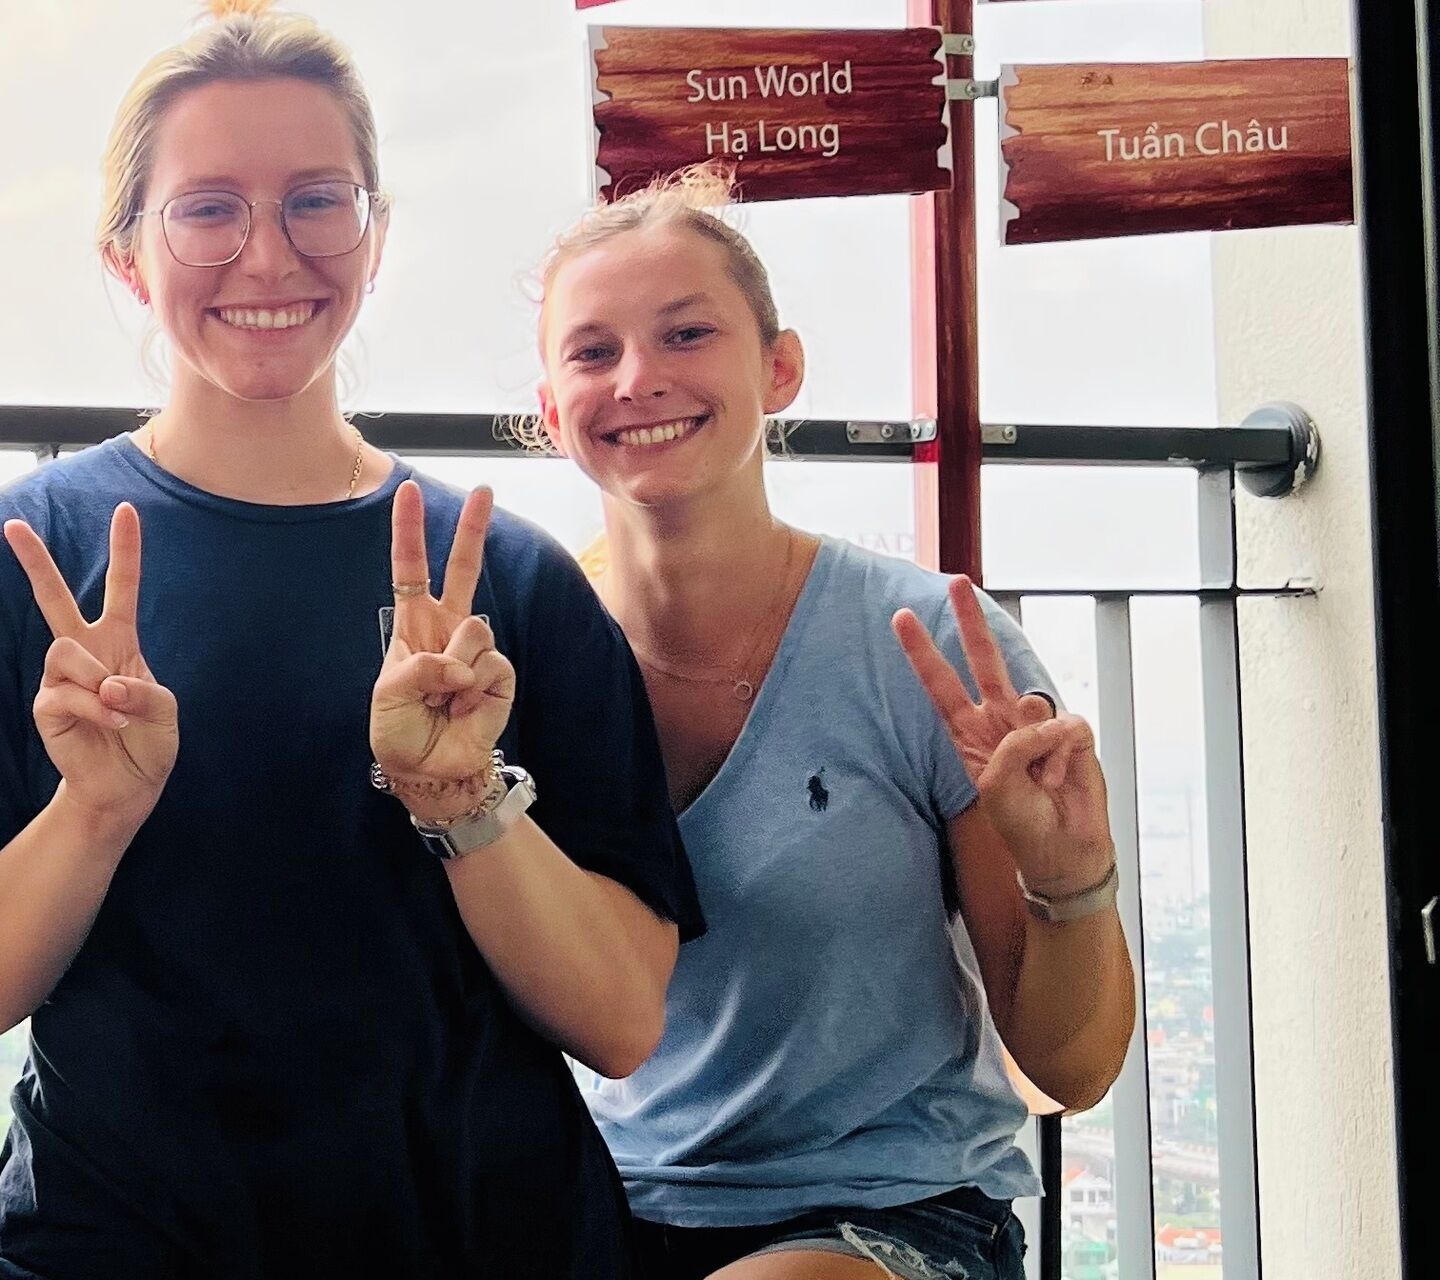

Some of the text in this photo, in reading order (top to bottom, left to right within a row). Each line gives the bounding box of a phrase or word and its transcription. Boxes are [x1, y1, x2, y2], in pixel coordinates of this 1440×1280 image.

[686, 60, 852, 103] Sun World
[705, 120, 840, 161] Hạ Long
[1097, 119, 1288, 161] Tuần Châu
